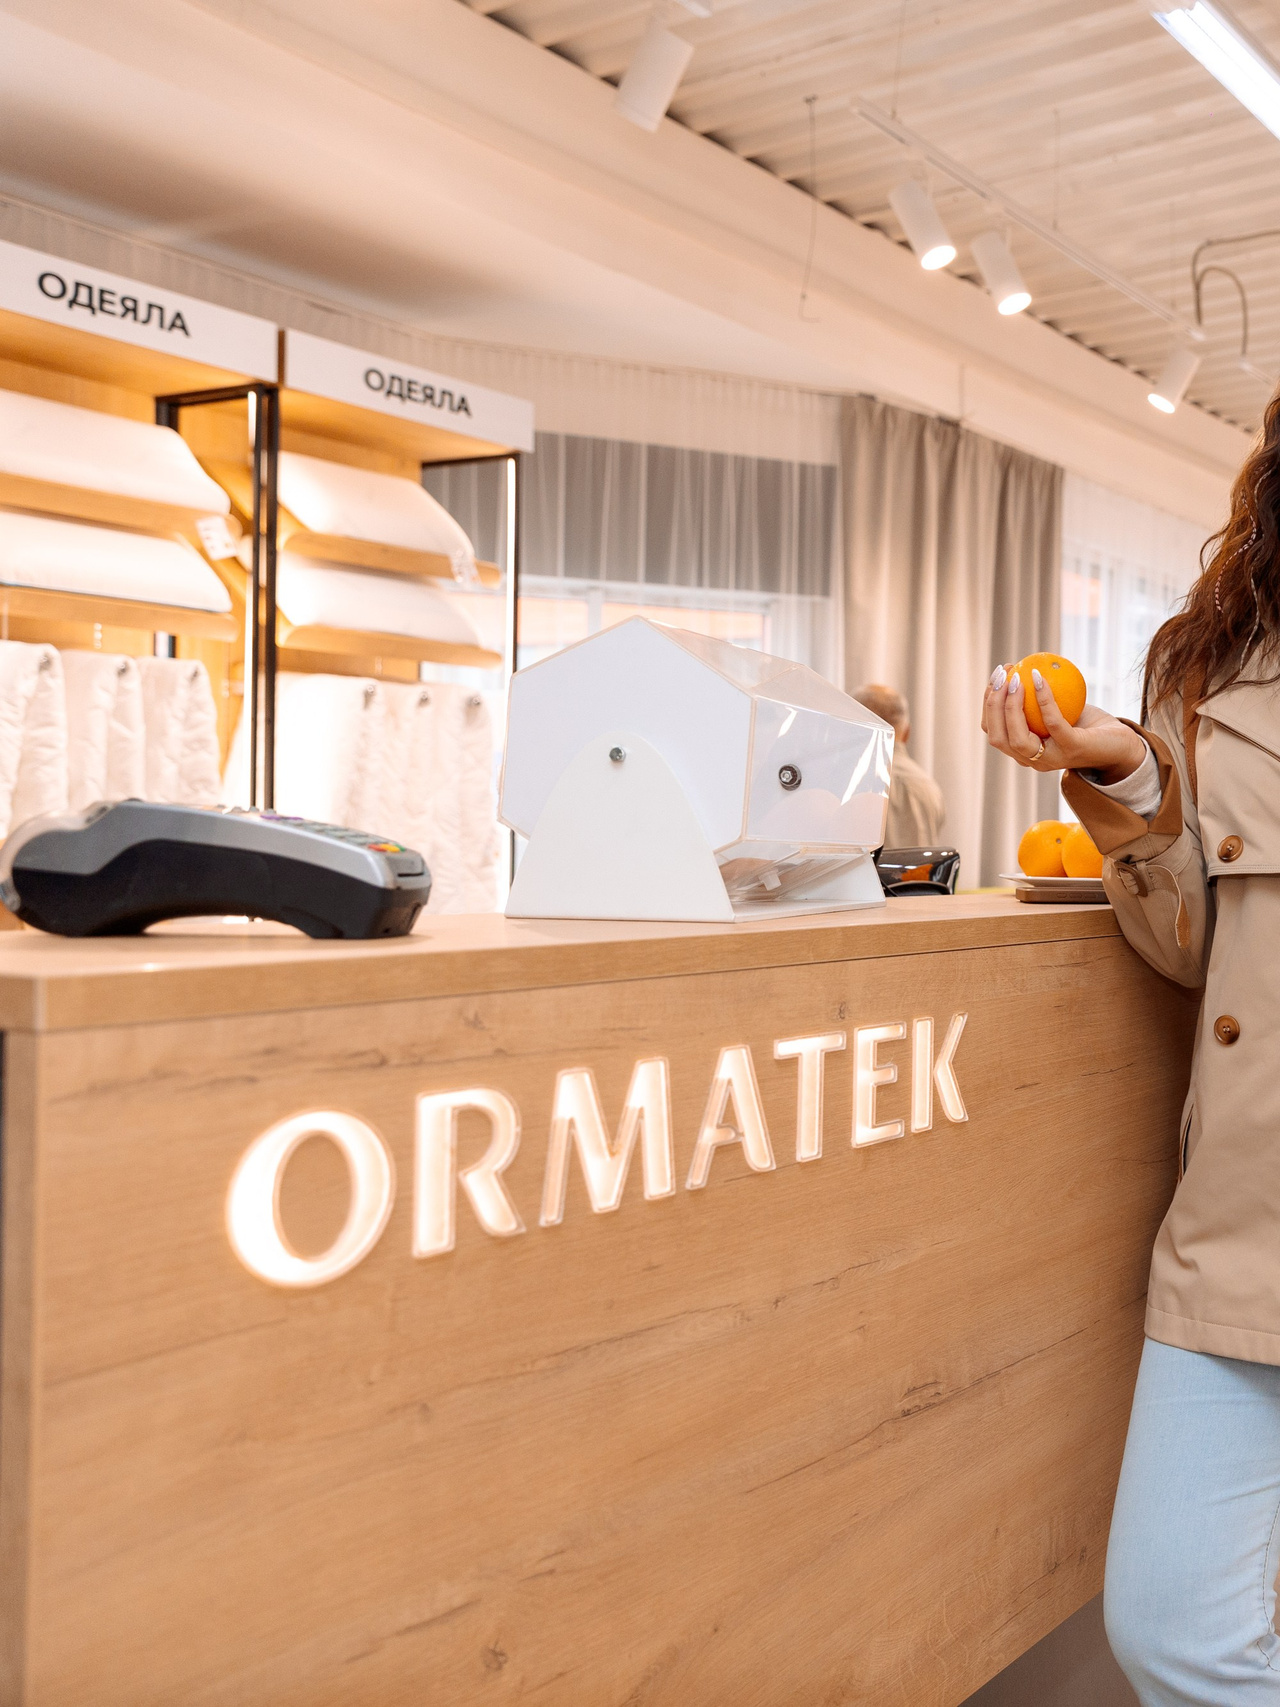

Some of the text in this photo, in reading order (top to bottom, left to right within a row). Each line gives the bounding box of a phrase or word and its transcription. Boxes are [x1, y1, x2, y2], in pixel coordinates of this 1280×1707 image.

[38, 272, 191, 338] ОДЕЯЛА
[364, 368, 472, 418] ОДЕЯЛА
[226, 1012, 969, 1287] ORMATEK
